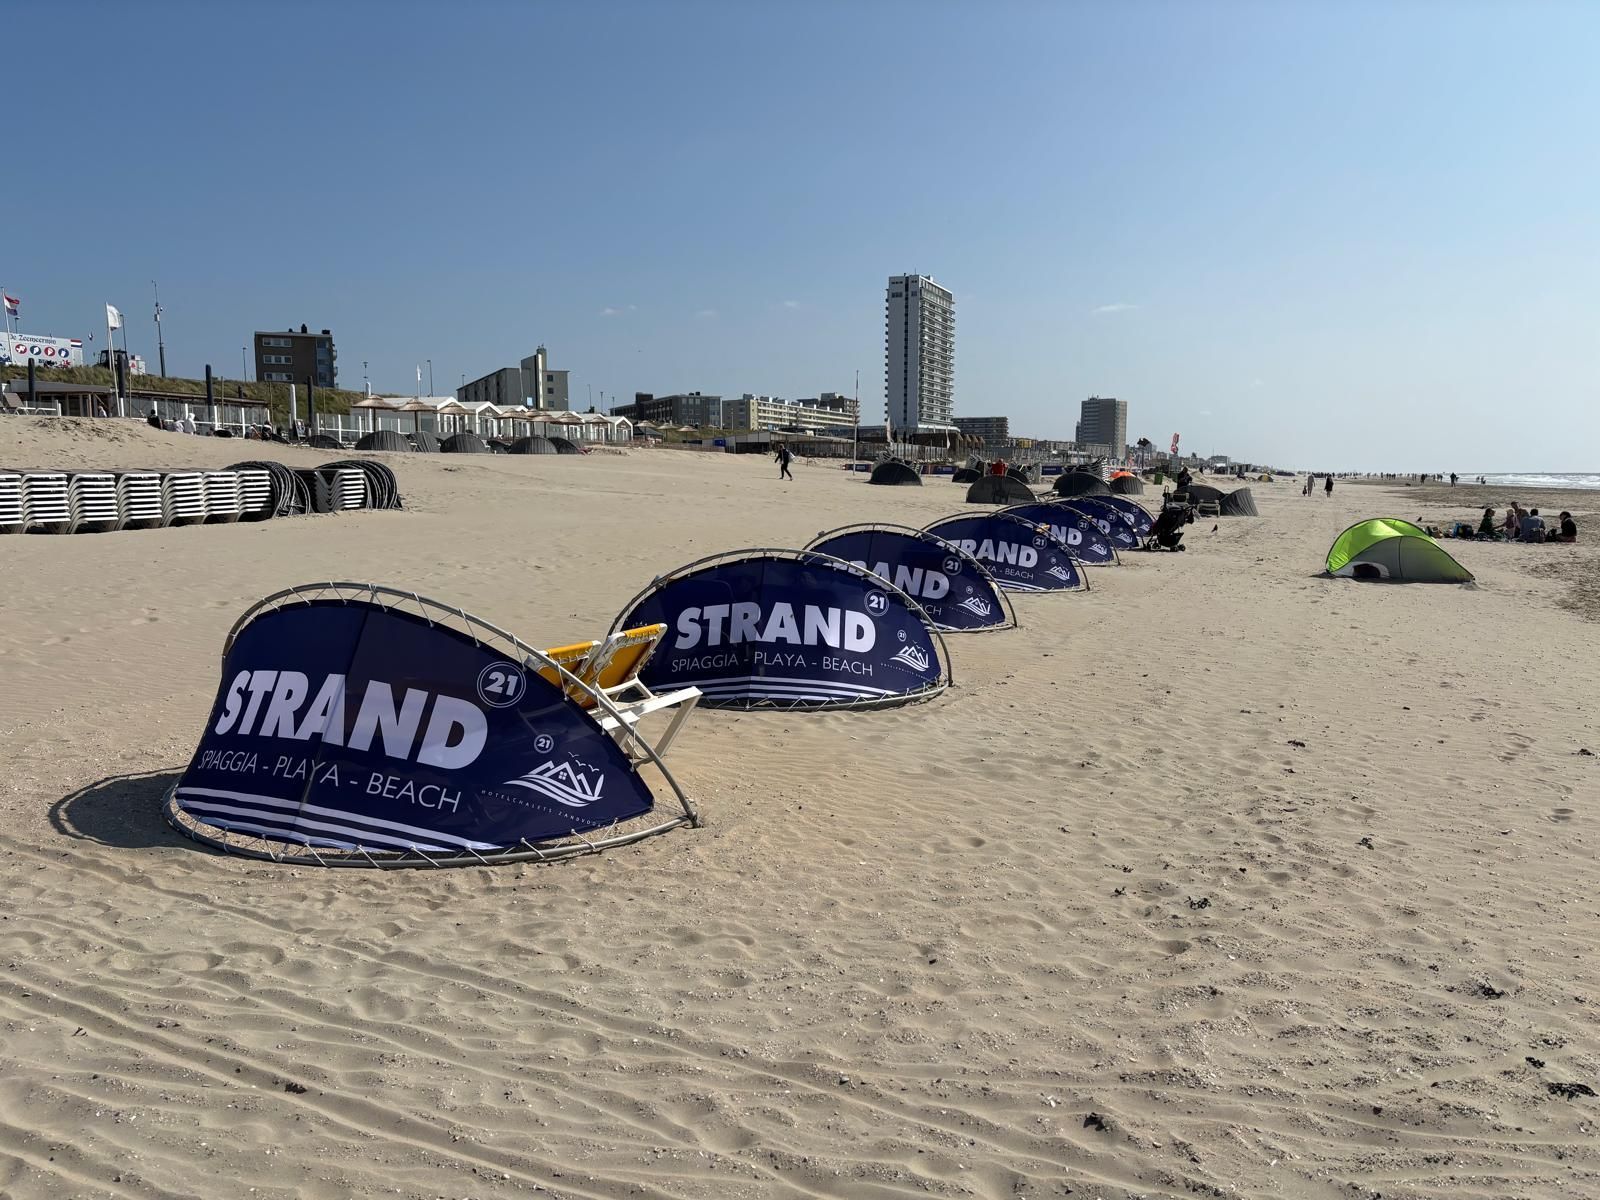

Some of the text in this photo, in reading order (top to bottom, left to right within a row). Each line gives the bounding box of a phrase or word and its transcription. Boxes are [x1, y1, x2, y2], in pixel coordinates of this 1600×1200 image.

[936, 538, 1038, 568] RAND
[1034, 537, 1045, 546] 21
[945, 560, 959, 571] 21
[1004, 567, 1034, 580] BEACH
[868, 594, 885, 610] 21
[674, 601, 876, 653] STRAND
[671, 653, 739, 673] SPIAGGIA
[753, 651, 807, 668] PLAYA
[822, 656, 874, 677] BEACH
[484, 671, 519, 697] 21
[214, 669, 488, 770] STRAND
[537, 738, 551, 749] 21
[197, 750, 258, 774] SPIAGGIA
[273, 755, 339, 787] PLAYA
[366, 772, 462, 813] BEACH
